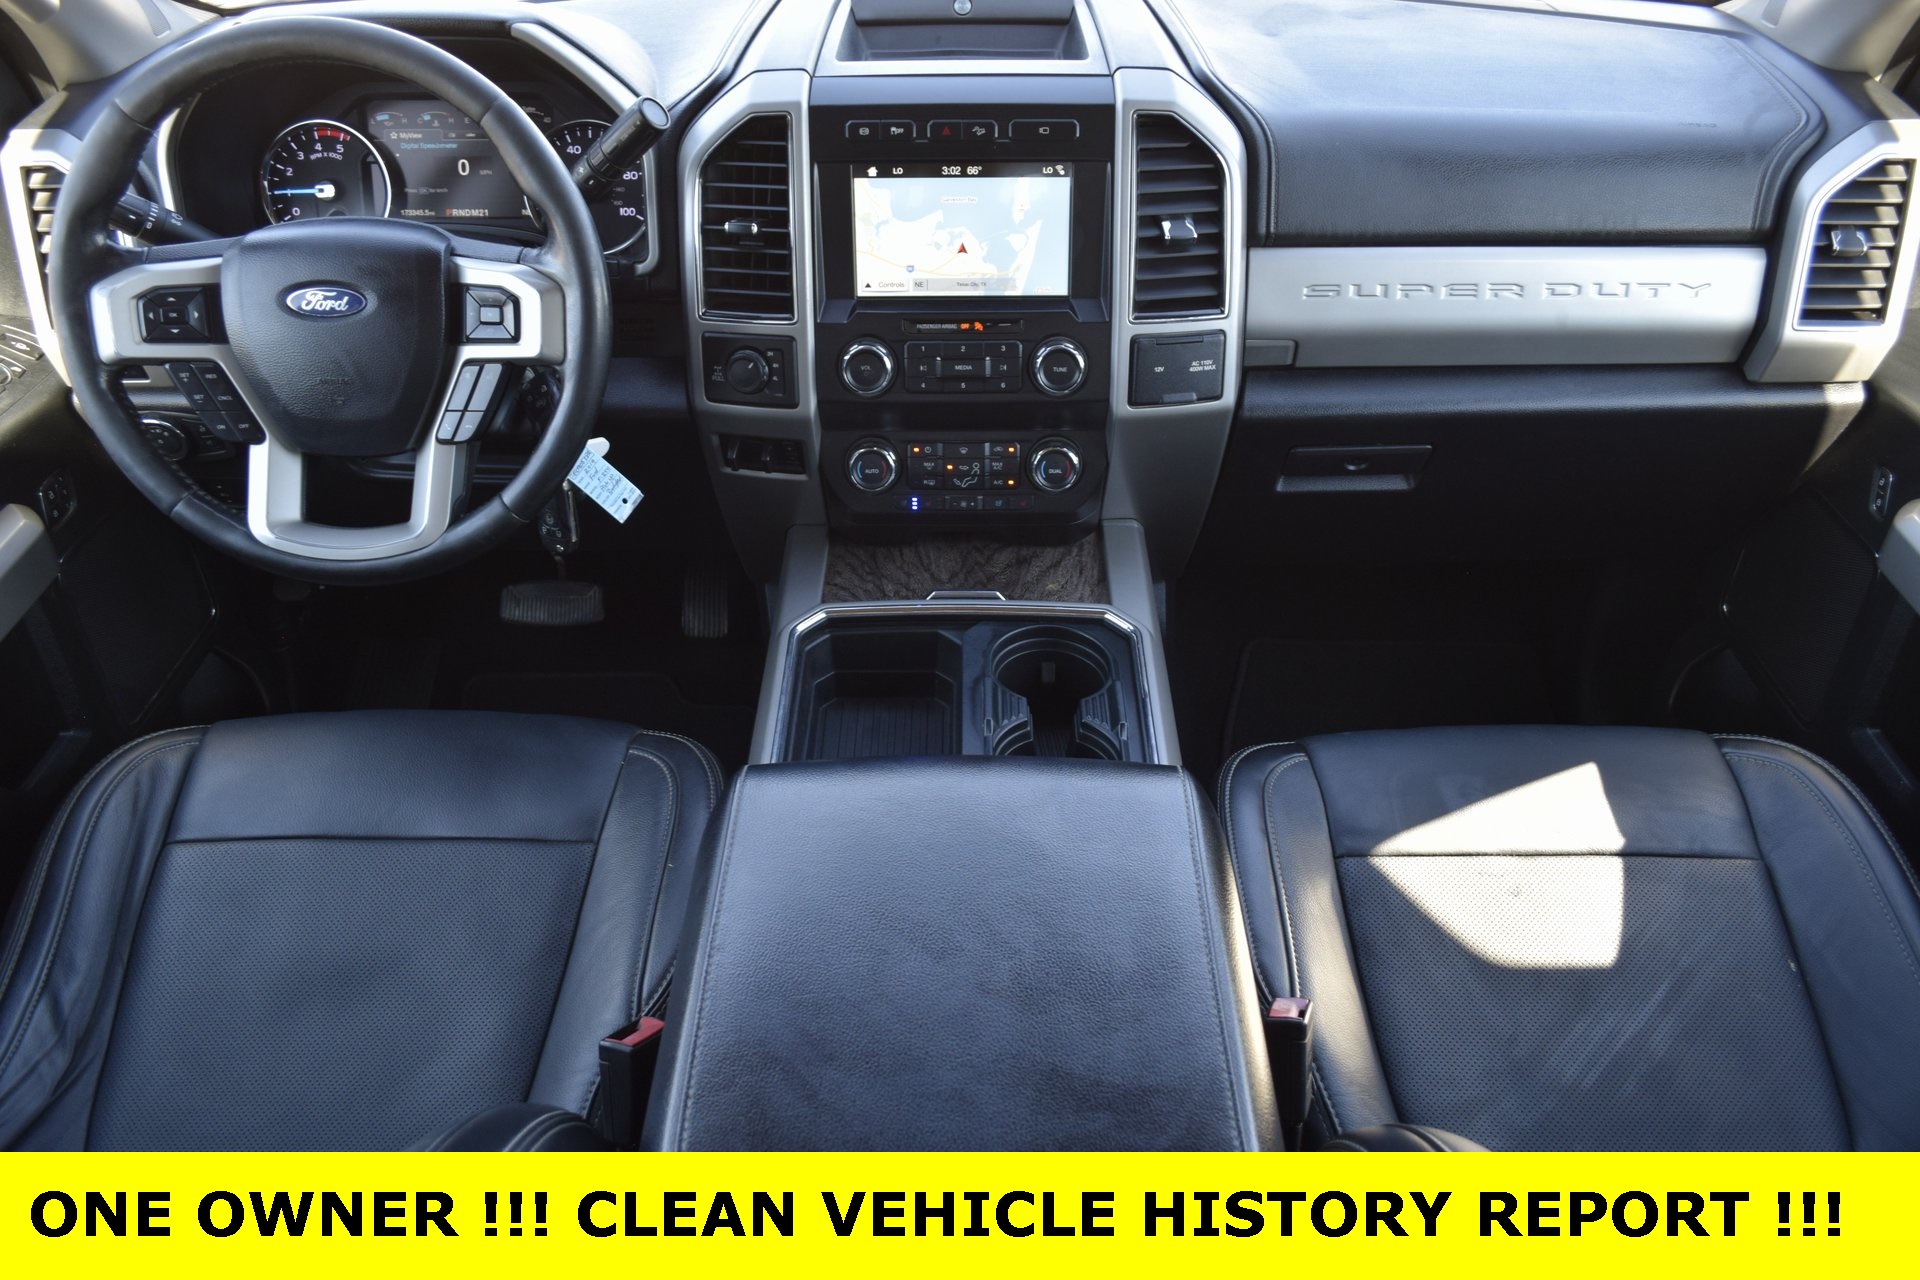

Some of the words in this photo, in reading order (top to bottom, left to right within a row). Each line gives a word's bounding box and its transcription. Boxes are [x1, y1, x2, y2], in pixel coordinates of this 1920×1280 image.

[400, 132, 422, 140] MyView
[315, 142, 322, 151] 4
[336, 144, 344, 153] 5
[566, 145, 582, 154] 40
[297, 152, 304, 160] 3
[310, 152, 322, 160] RPM
[329, 152, 343, 160] 1000
[286, 167, 294, 176] 2
[457, 159, 470, 176] 0
[942, 166, 961, 175] 3:02
[622, 171, 638, 180] 80
[292, 208, 300, 216] 0
[620, 207, 636, 216] 100
[1302, 282, 1525, 300] SUPER
[1542, 282, 1712, 299] DUTY
[301, 290, 349, 311] Ford
